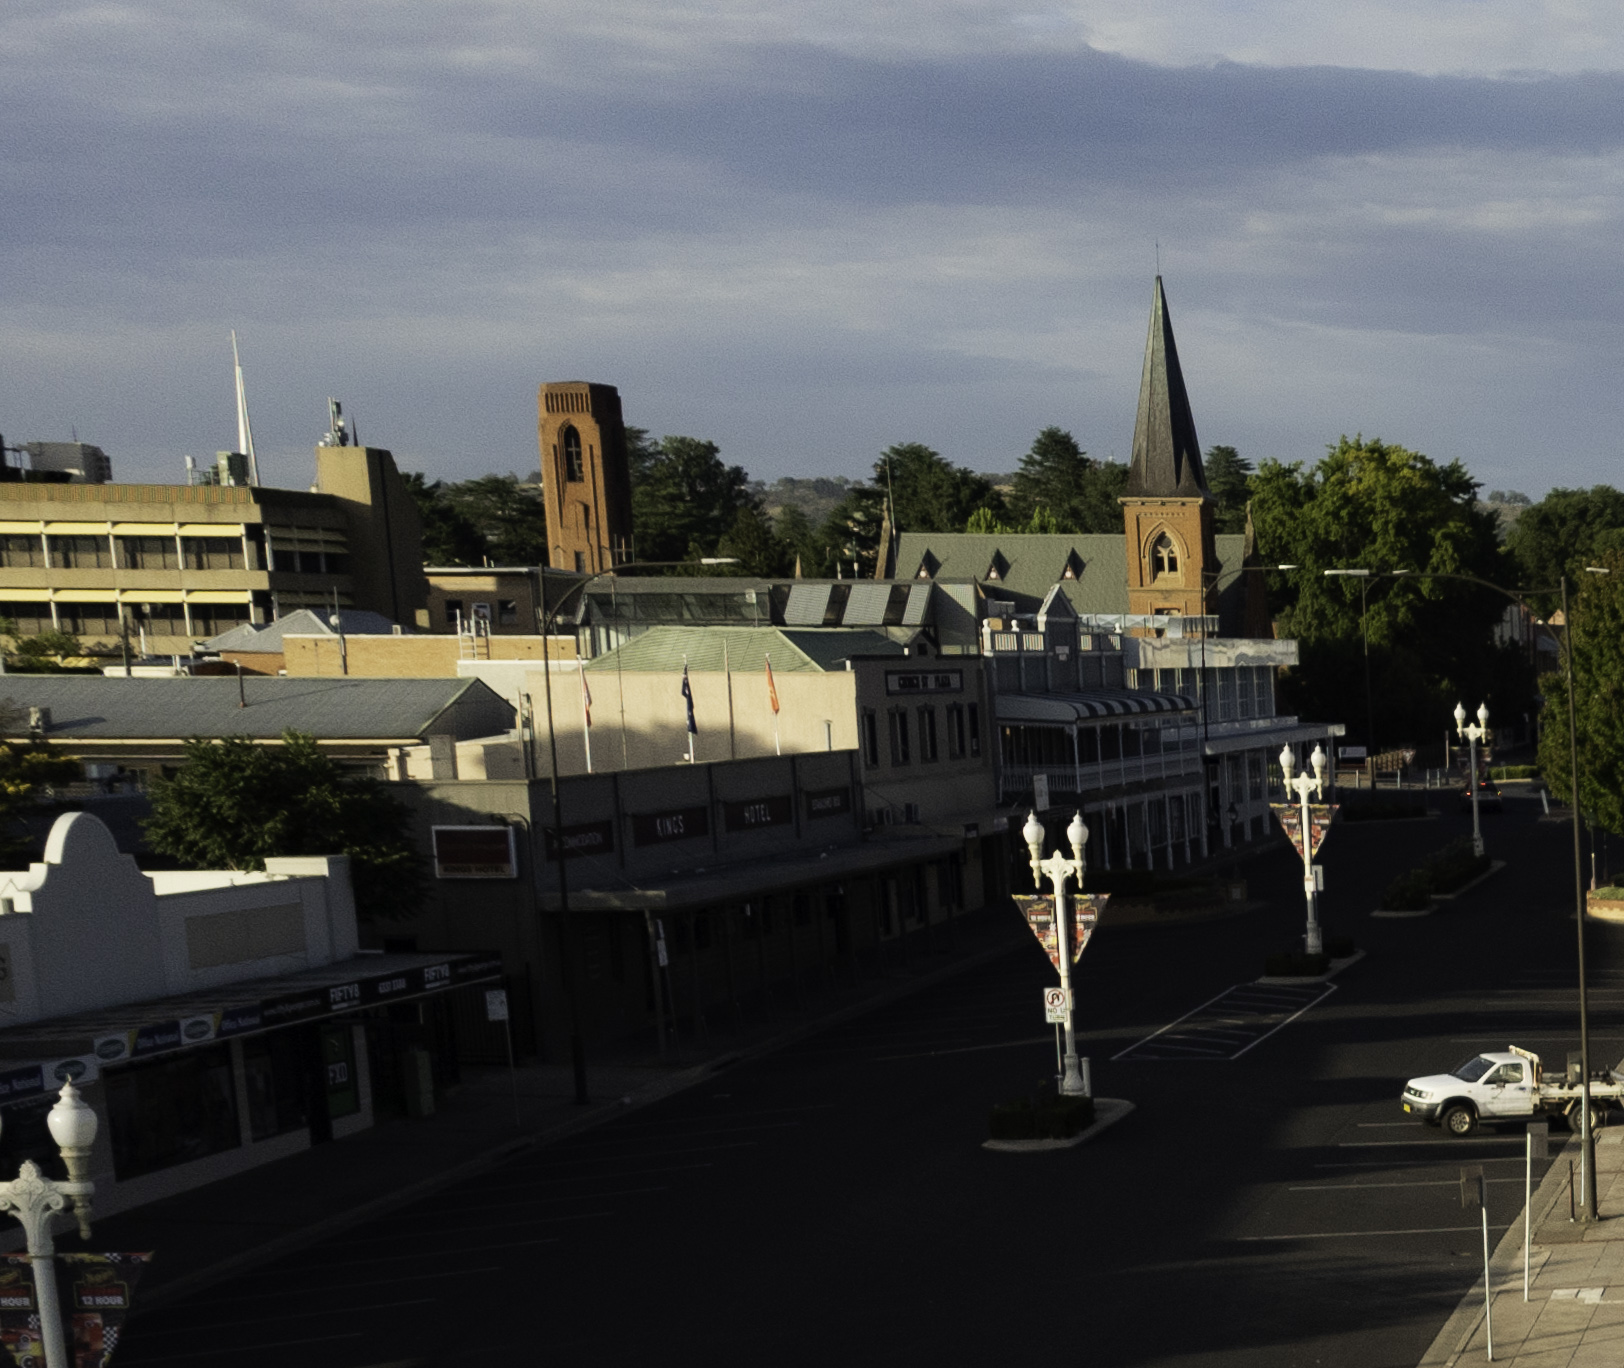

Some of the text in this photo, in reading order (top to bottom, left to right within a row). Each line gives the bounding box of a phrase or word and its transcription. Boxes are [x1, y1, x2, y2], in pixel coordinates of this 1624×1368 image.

[744, 803, 772, 825] HOTEL
[656, 814, 686, 839] KINGS
[94, 1296, 124, 1306] HOUR
